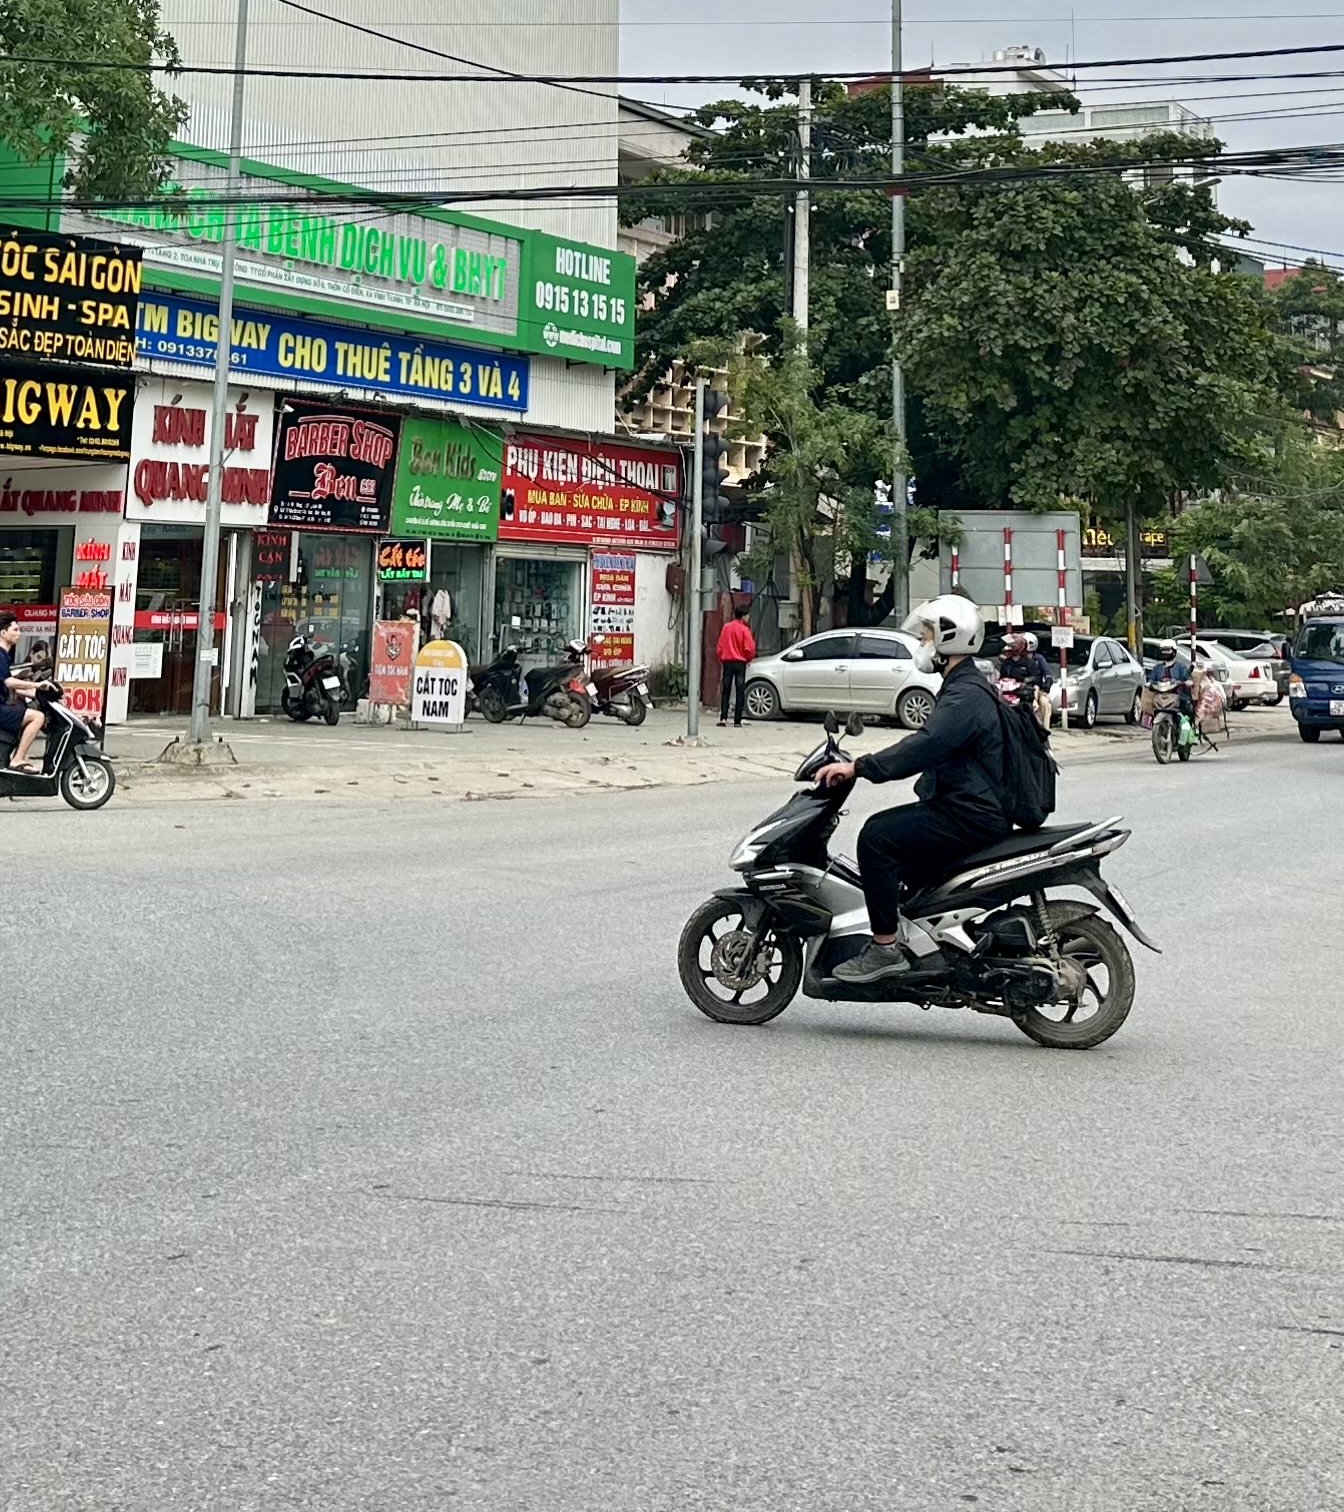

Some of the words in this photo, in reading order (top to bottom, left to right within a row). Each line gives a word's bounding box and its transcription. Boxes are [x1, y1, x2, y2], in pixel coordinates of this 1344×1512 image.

[44, 240, 87, 287] SÀI
[91, 246, 143, 294] GÒN
[340, 222, 395, 286] DỊCH
[398, 235, 427, 295] VỤ
[429, 243, 448, 291] &
[452, 247, 508, 301] BHYT
[556, 247, 611, 285] HOTLINE
[81, 300, 131, 329] SPA
[536, 281, 569, 314] 0915
[573, 289, 589, 318] 13
[592, 293, 607, 321] 15
[610, 297, 625, 325] 15
[34, 331, 63, 358] ĐẸP
[65, 330, 105, 360] TOÀN
[106, 335, 136, 365] DIỆN
[177, 308, 271, 351] BIGWAY
[278, 332, 327, 373] CHO
[335, 341, 391, 382] THUÊ
[398, 344, 454, 392] TẦNG
[459, 362, 472, 394] 3
[478, 361, 503, 399] VÀ
[508, 370, 520, 402] 4
[152, 394, 206, 447] KÍNH
[285, 423, 349, 461] BARBER
[350, 420, 393, 469] SHOP
[134, 459, 210, 506] QUANG
[221, 467, 269, 504] MINH
[311, 462, 357, 501] Ben
[507, 446, 538, 484] PHỤ
[542, 449, 578, 486] KIỆN
[581, 453, 616, 490] ĐIỆN
[619, 459, 659, 495] THOẠI
[21, 490, 77, 516] QUANG
[80, 490, 124, 512] MINH
[467, 497, 474, 513] &
[528, 490, 548, 505] MUA
[549, 488, 567, 506] BÁN
[573, 490, 590, 508] SỬA
[591, 493, 614, 512] CHỮA
[77, 538, 112, 561] KÍNH
[122, 535, 136, 561] KÍNH
[257, 533, 287, 546] KÍNH
[258, 551, 284, 565] CẬN
[379, 542, 403, 568] Cắt
[405, 545, 425, 568] tóc
[77, 564, 109, 589] MẮT
[119, 573, 133, 602] MẮT
[62, 608, 89, 618] BARBER
[90, 608, 109, 619] SHOP
[59, 625, 83, 660] CẮT
[85, 629, 106, 660] TÓC
[113, 624, 133, 648] QUANG
[58, 663, 100, 683] NAM
[416, 670, 436, 696] CẮT
[439, 673, 458, 696] TÓC
[63, 688, 102, 713] 50K
[422, 701, 450, 718] NAM
